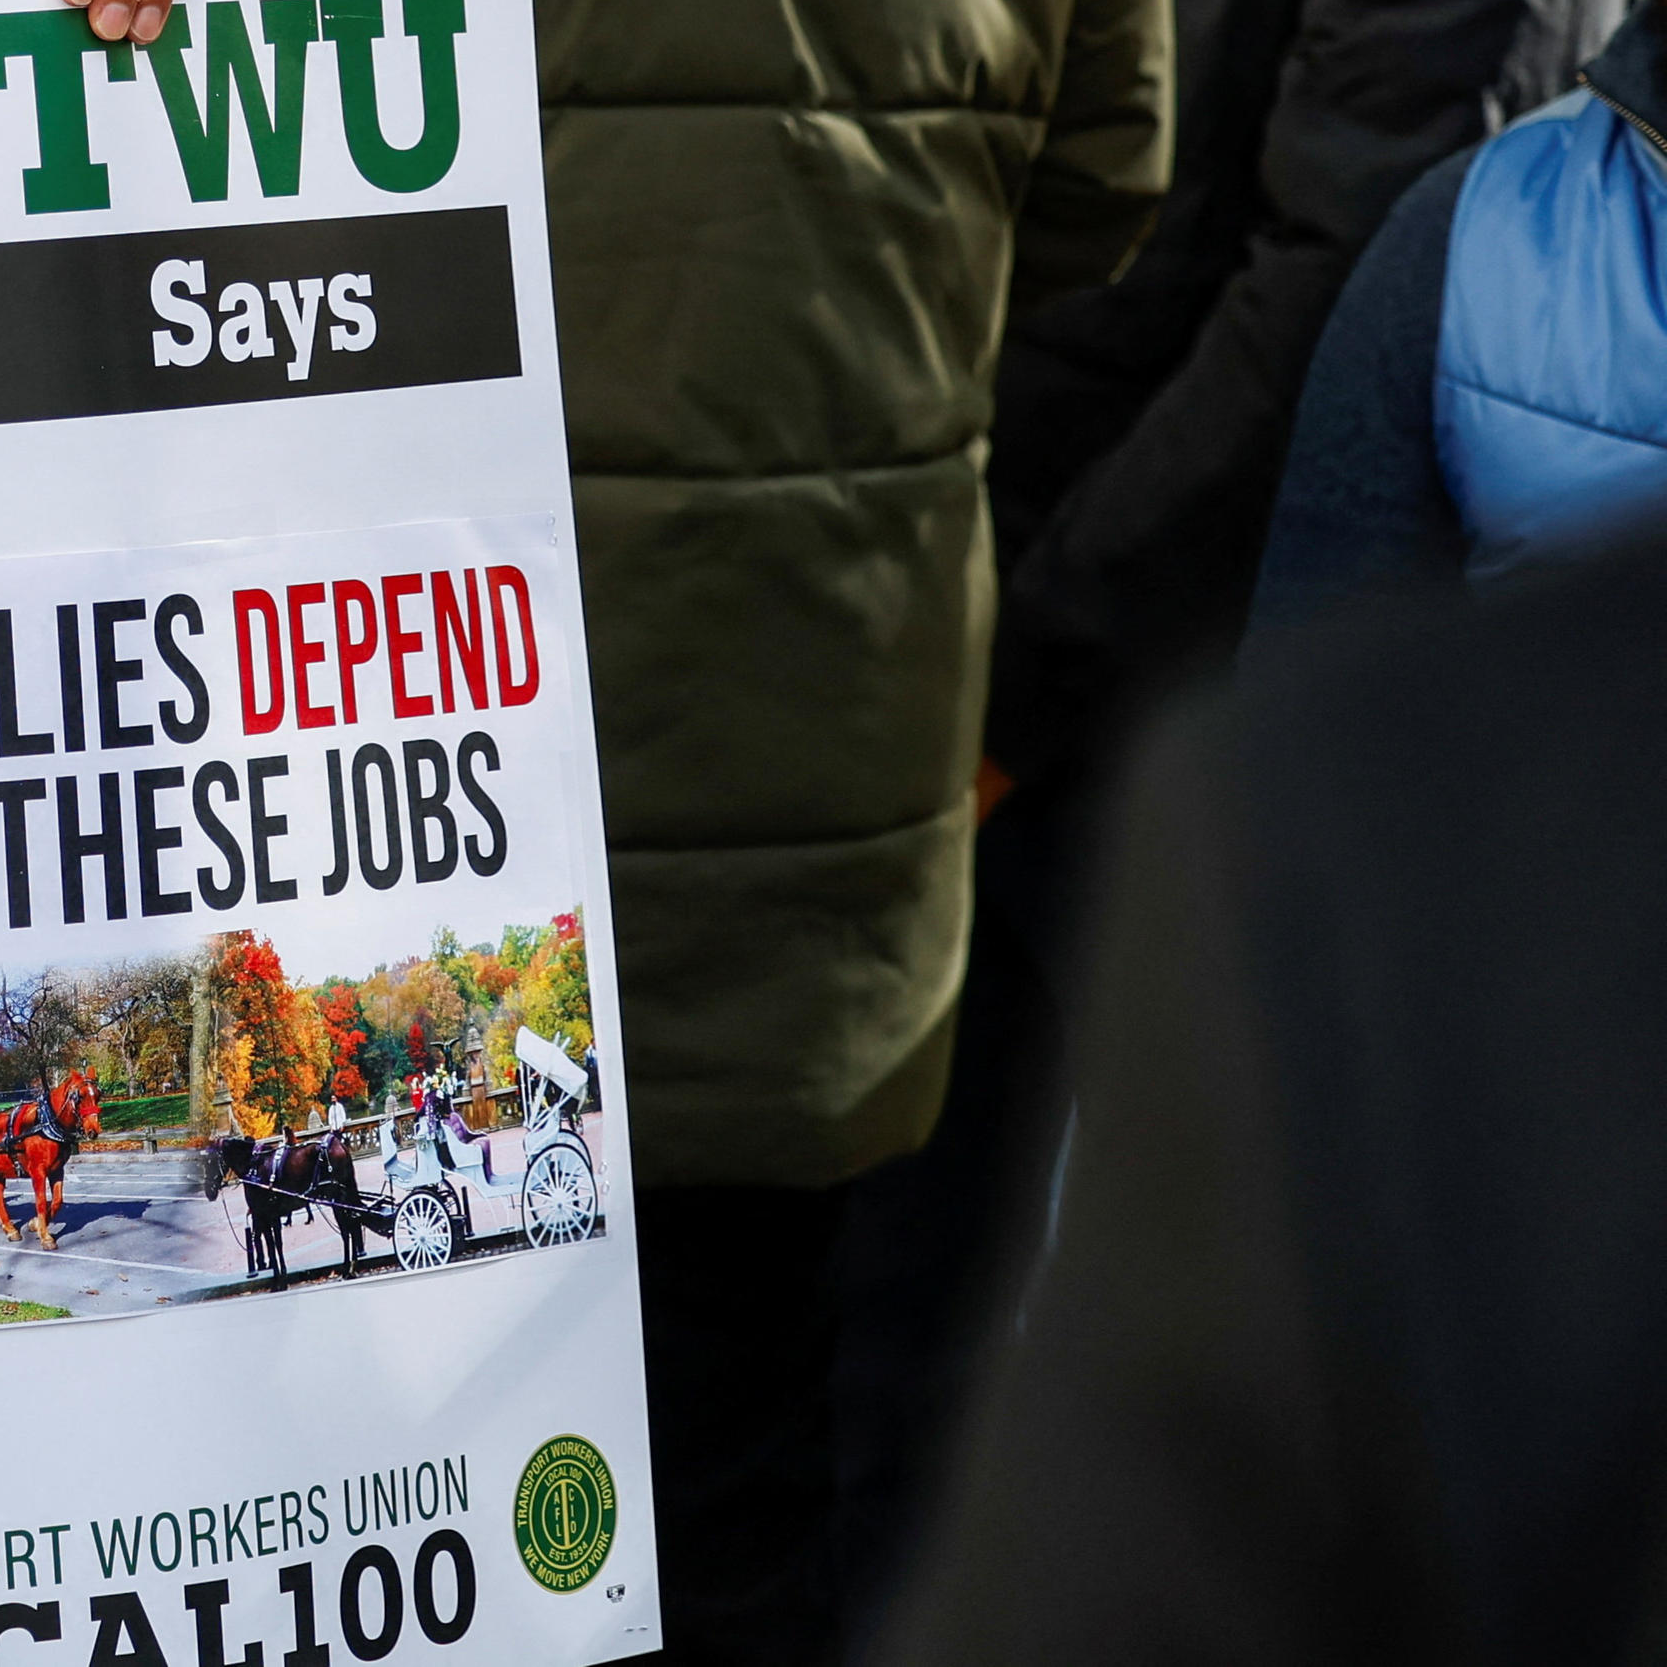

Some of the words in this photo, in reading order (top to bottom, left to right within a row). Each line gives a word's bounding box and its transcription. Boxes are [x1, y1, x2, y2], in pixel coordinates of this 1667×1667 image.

[149, 258, 379, 382] Says
[232, 564, 541, 736] DEPEND
[322, 730, 508, 897] JOBS
[89, 1484, 331, 1580] WORKERS
[343, 1454, 470, 1537] UNION
[517, 1448, 550, 1528] TRANSPORT
[550, 1441, 598, 1468] WORKERS
[595, 1464, 613, 1510] UNION
[544, 1466, 568, 1487] LOCAL
[523, 1543, 540, 1570] WE
[535, 1563, 566, 1588] MOVE
[566, 1562, 590, 1587] NEW
[587, 1530, 611, 1567] YORK
